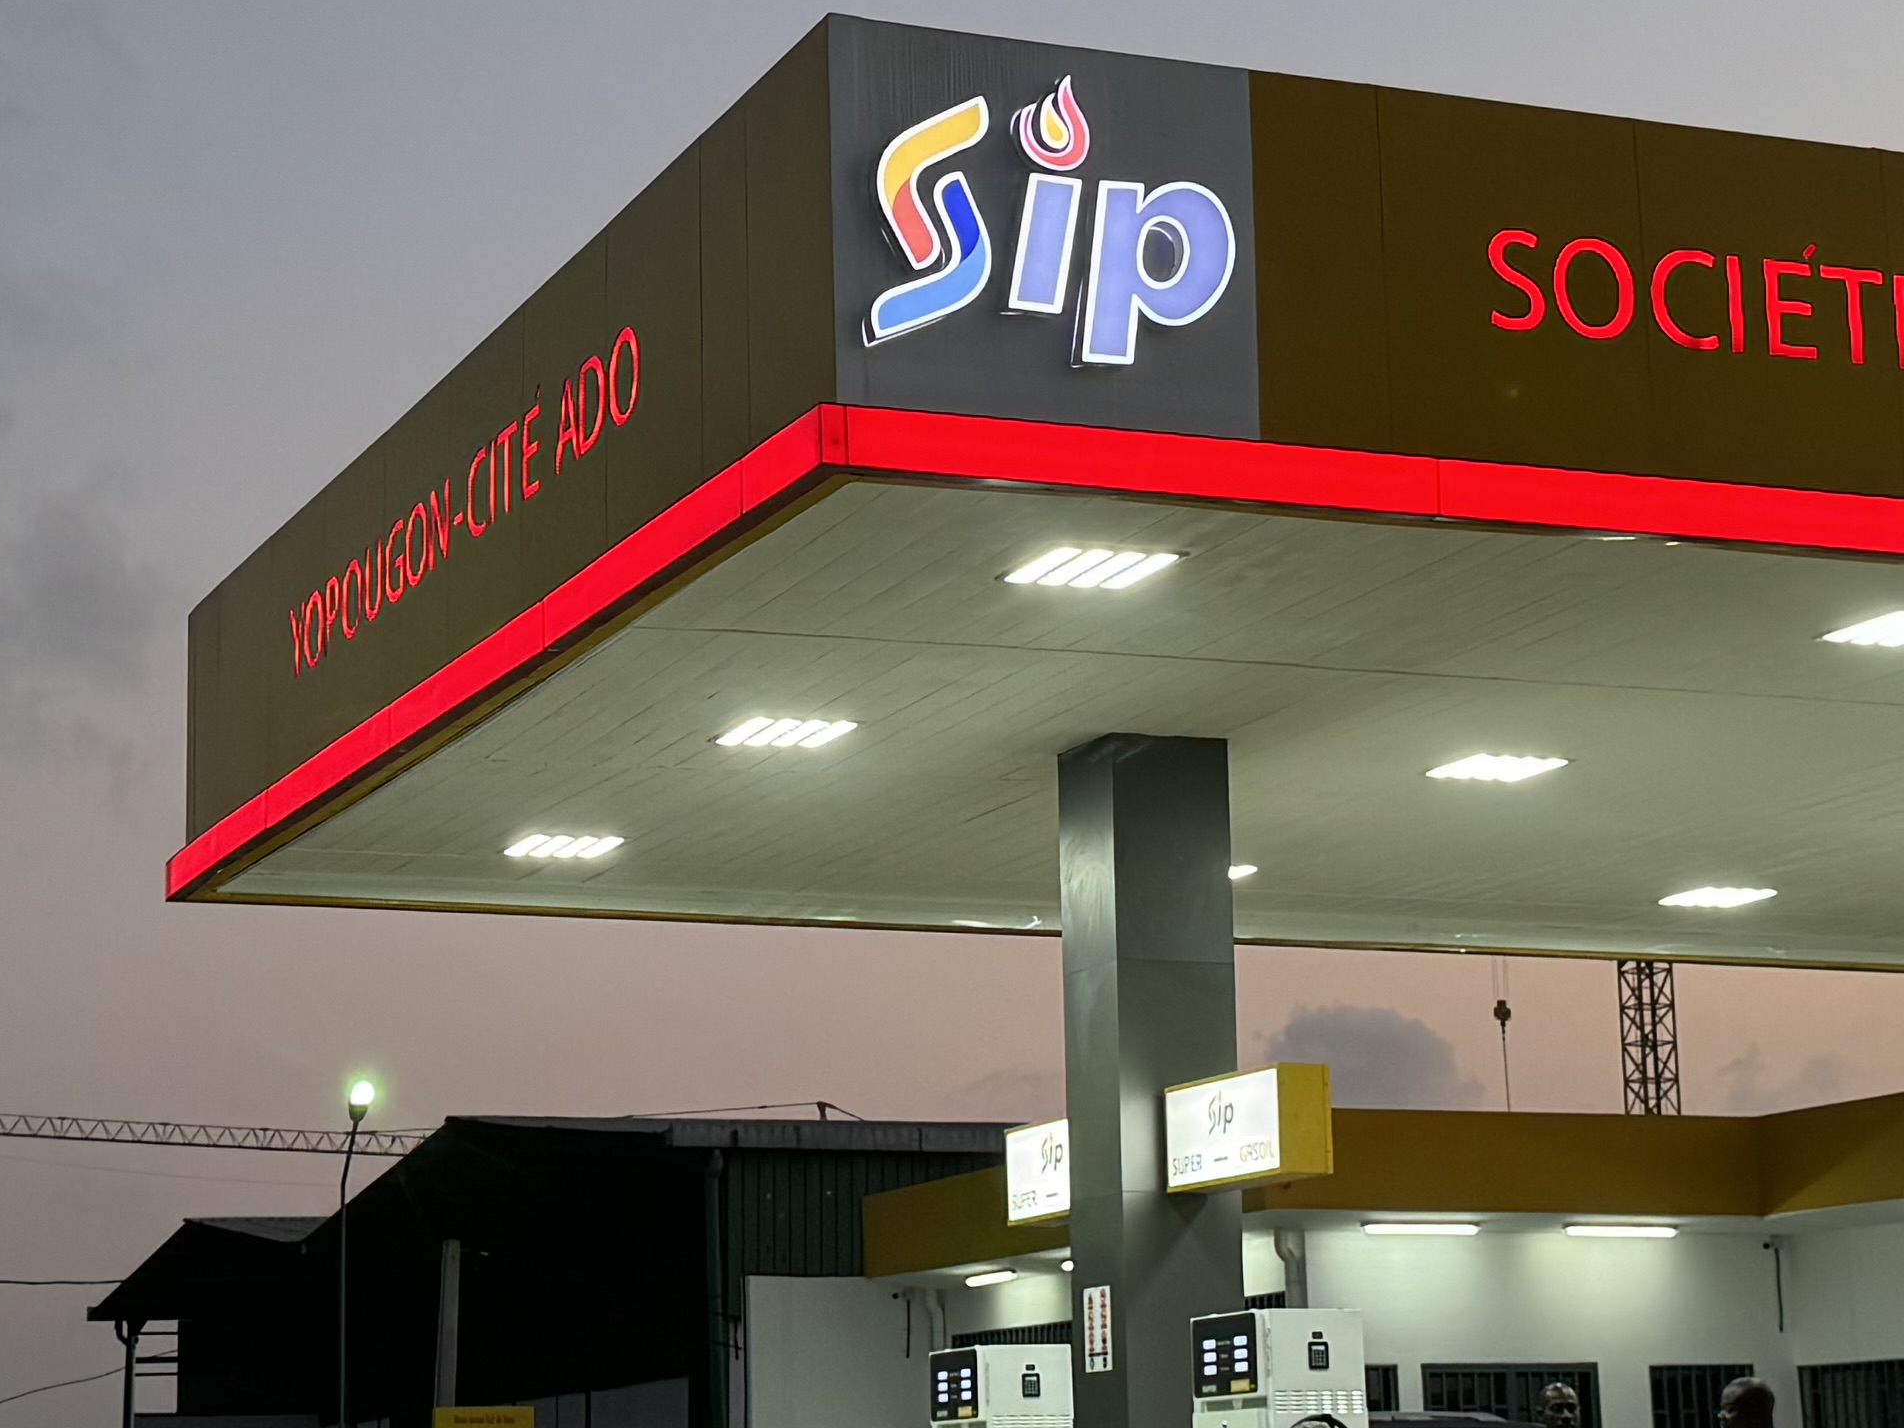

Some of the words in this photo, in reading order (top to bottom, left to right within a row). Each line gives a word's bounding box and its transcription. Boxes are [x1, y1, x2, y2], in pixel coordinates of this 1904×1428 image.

[289, 384, 542, 678] YOPOUGON-CITÉ
[555, 326, 641, 475] ADO
[1173, 1154, 1202, 1176] SUPER
